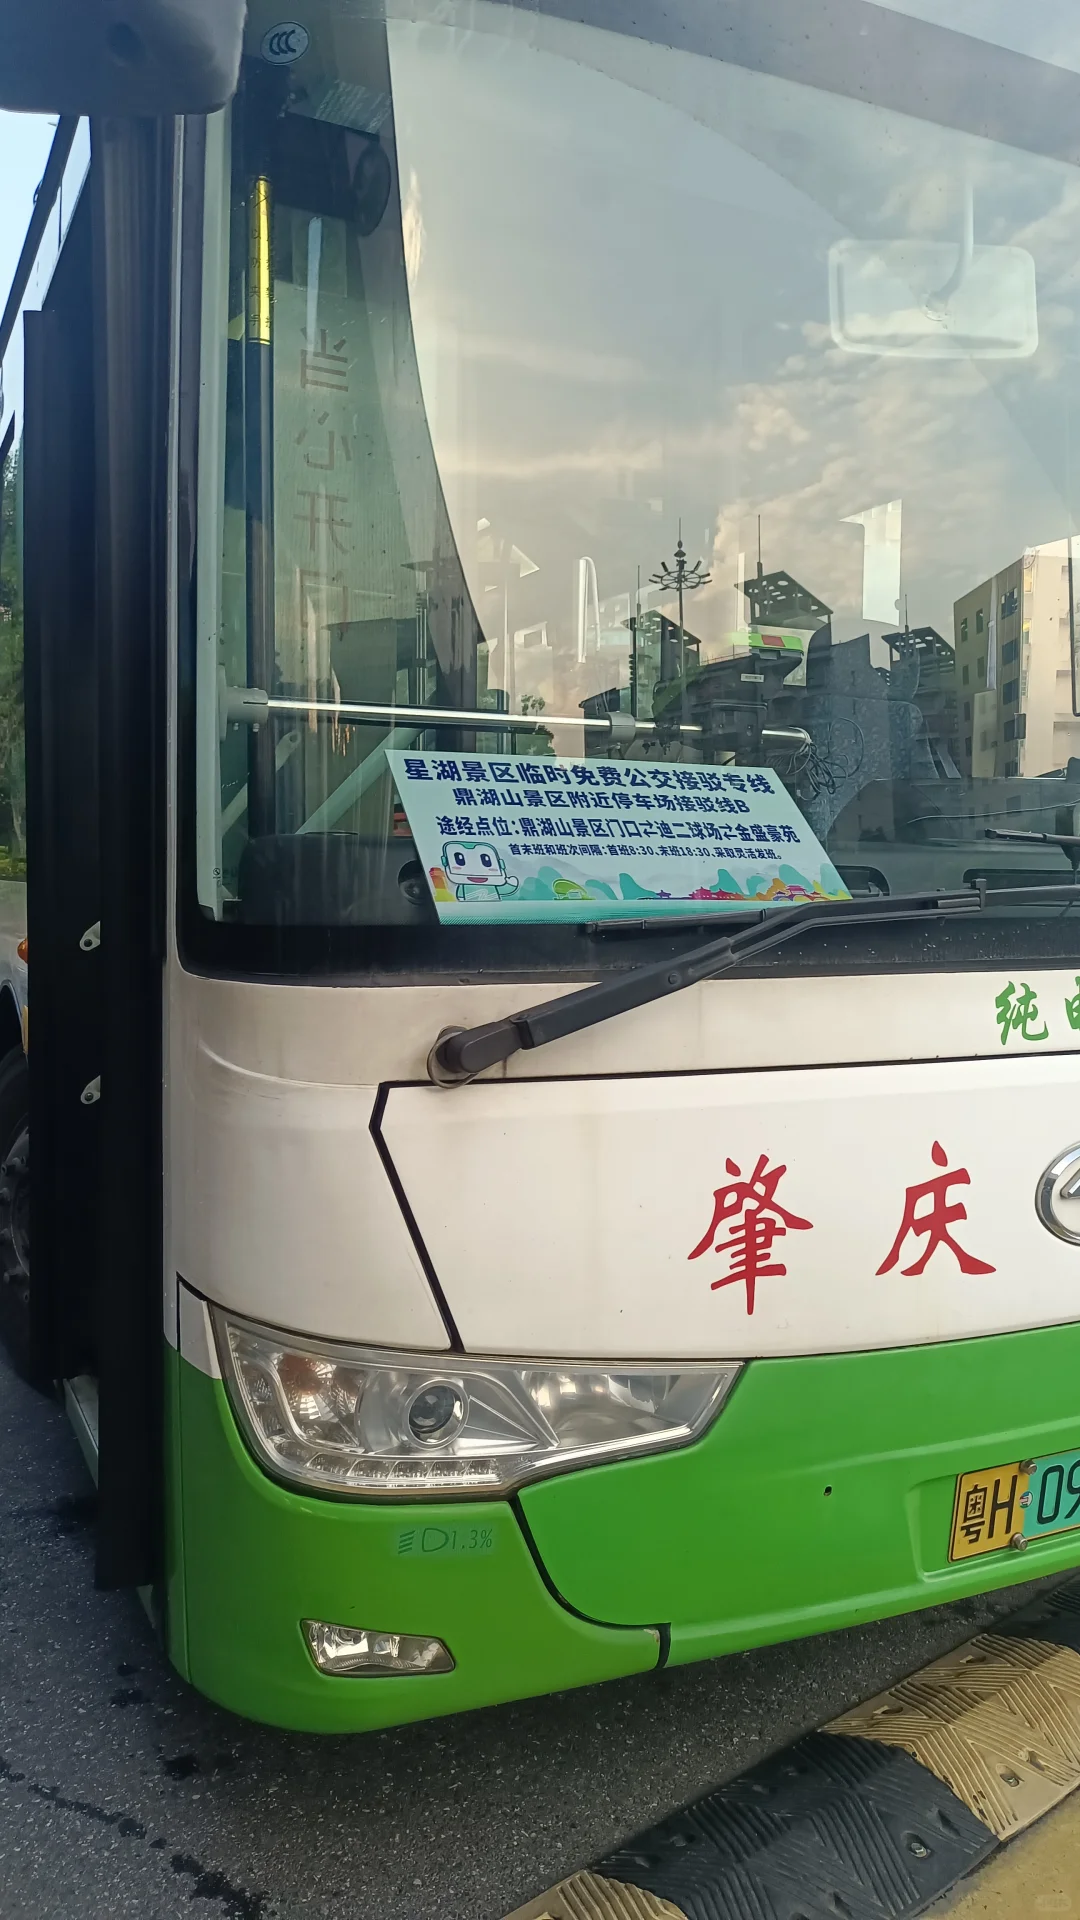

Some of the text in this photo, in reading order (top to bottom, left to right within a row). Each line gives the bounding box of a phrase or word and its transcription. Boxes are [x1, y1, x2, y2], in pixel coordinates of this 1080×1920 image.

[403, 758, 776, 795] 星湖景区临时免费公交接驳专线
[452, 787, 751, 814] 鼎湖山景区附近停车场接驳线B
[687, 1140, 997, 1316] 肇庆
